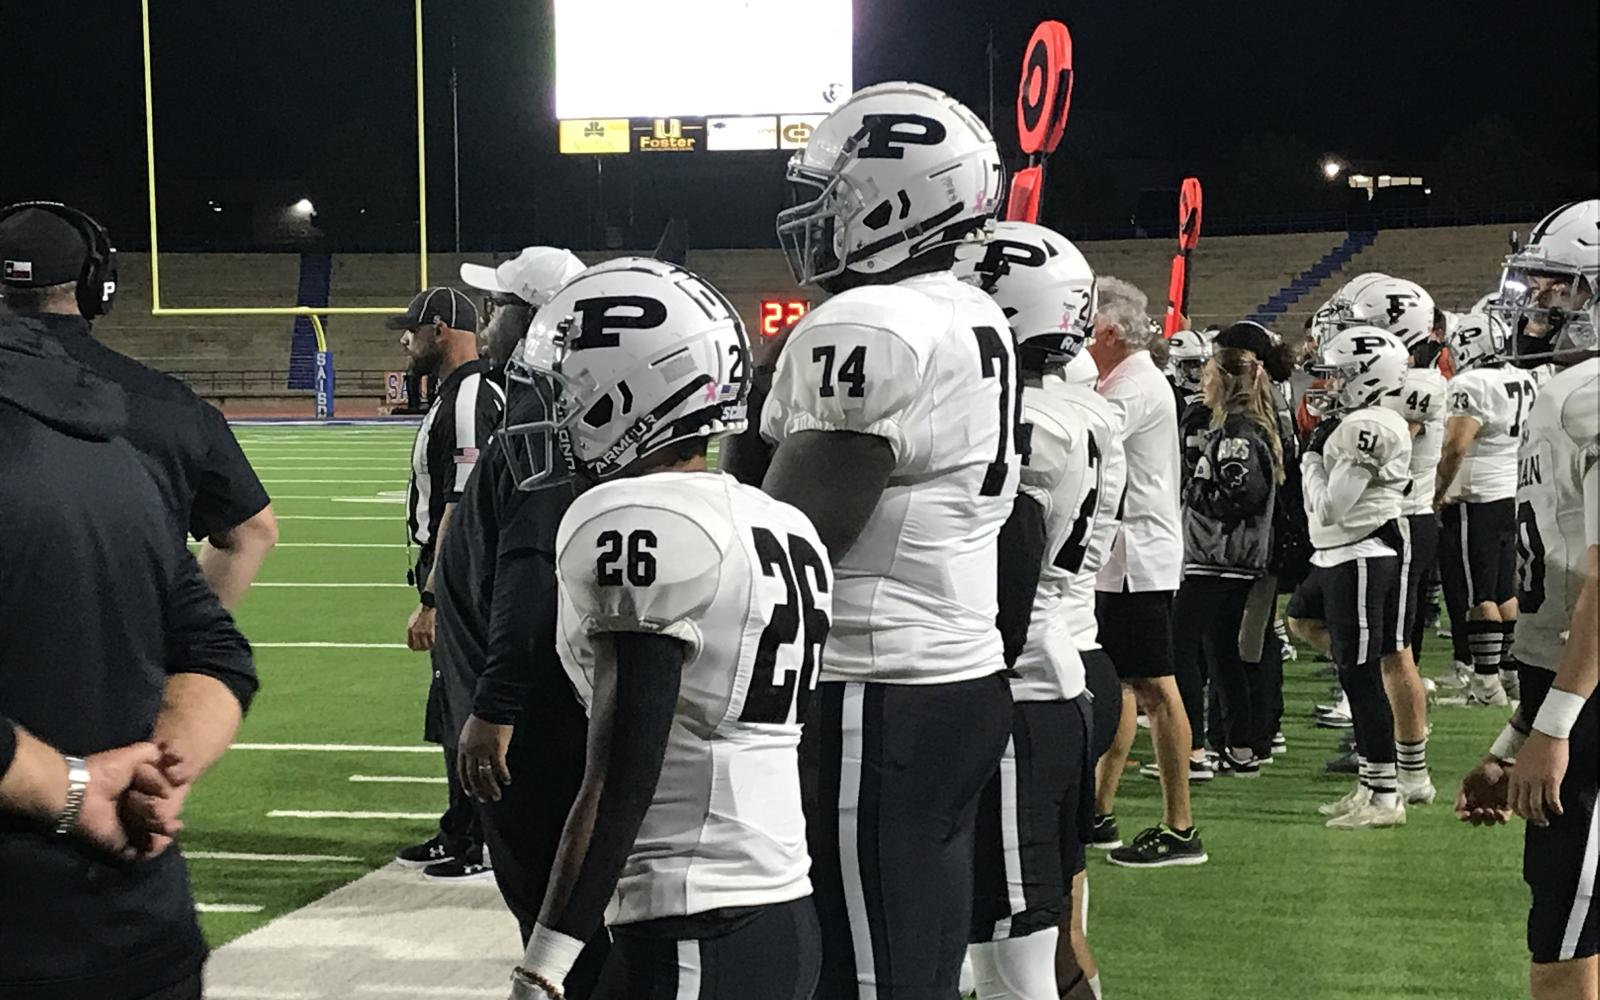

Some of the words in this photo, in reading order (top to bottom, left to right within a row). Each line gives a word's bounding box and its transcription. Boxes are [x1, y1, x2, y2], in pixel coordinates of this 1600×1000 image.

[640, 136, 696, 148] Foster
[858, 114, 946, 159] P
[974, 239, 1046, 276] P
[102, 281, 116, 301] P
[572, 296, 667, 350] P
[1458, 327, 1482, 347] P
[1351, 336, 1387, 356] P
[316, 352, 327, 419] SAISD
[813, 345, 867, 397] 74
[1406, 390, 1431, 413] 44
[1452, 392, 1469, 410] 73
[595, 414, 657, 473] ARMOUR
[1357, 430, 1379, 452] 51
[596, 529, 658, 587] 26
[737, 526, 830, 725] 26
